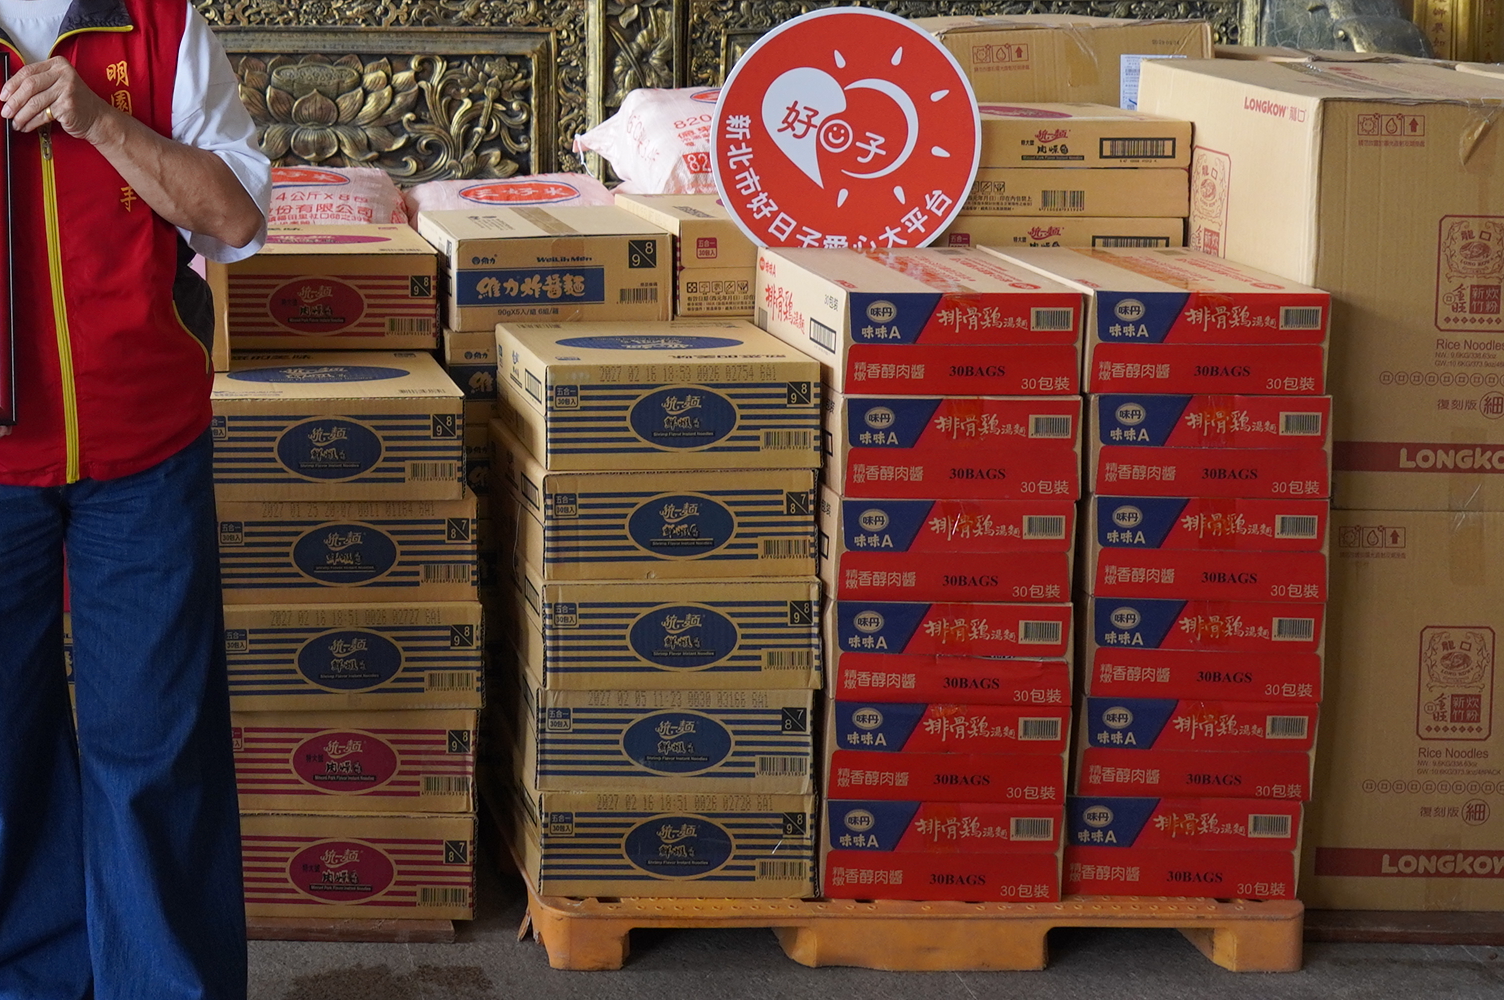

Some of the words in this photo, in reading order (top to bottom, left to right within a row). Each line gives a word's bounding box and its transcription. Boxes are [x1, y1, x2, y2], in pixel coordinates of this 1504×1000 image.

[1244, 96, 1287, 118] LONGKOW
[475, 274, 586, 300] 維力炸醬麵
[870, 307, 893, 318] 味丹
[1118, 305, 1141, 316] 味丹
[861, 325, 901, 340] 味味A
[1109, 323, 1149, 338] 味味A
[1436, 339, 1461, 350] Rice
[949, 365, 1006, 377] 30BAGS
[1021, 377, 1070, 391] 30包裝
[1266, 377, 1315, 391] 30包裝
[1437, 398, 1477, 411] 復刻版
[949, 468, 1006, 480] 30BAGS
[1106, 712, 1129, 723] 味丹
[1097, 731, 1137, 745] 味味A
[1418, 748, 1442, 759] Rice
[1446, 748, 1490, 759] Noodles
[1186, 774, 1242, 786] 30BAGS
[1255, 784, 1302, 799] 30包裝
[1420, 807, 1459, 818] 復刻版
